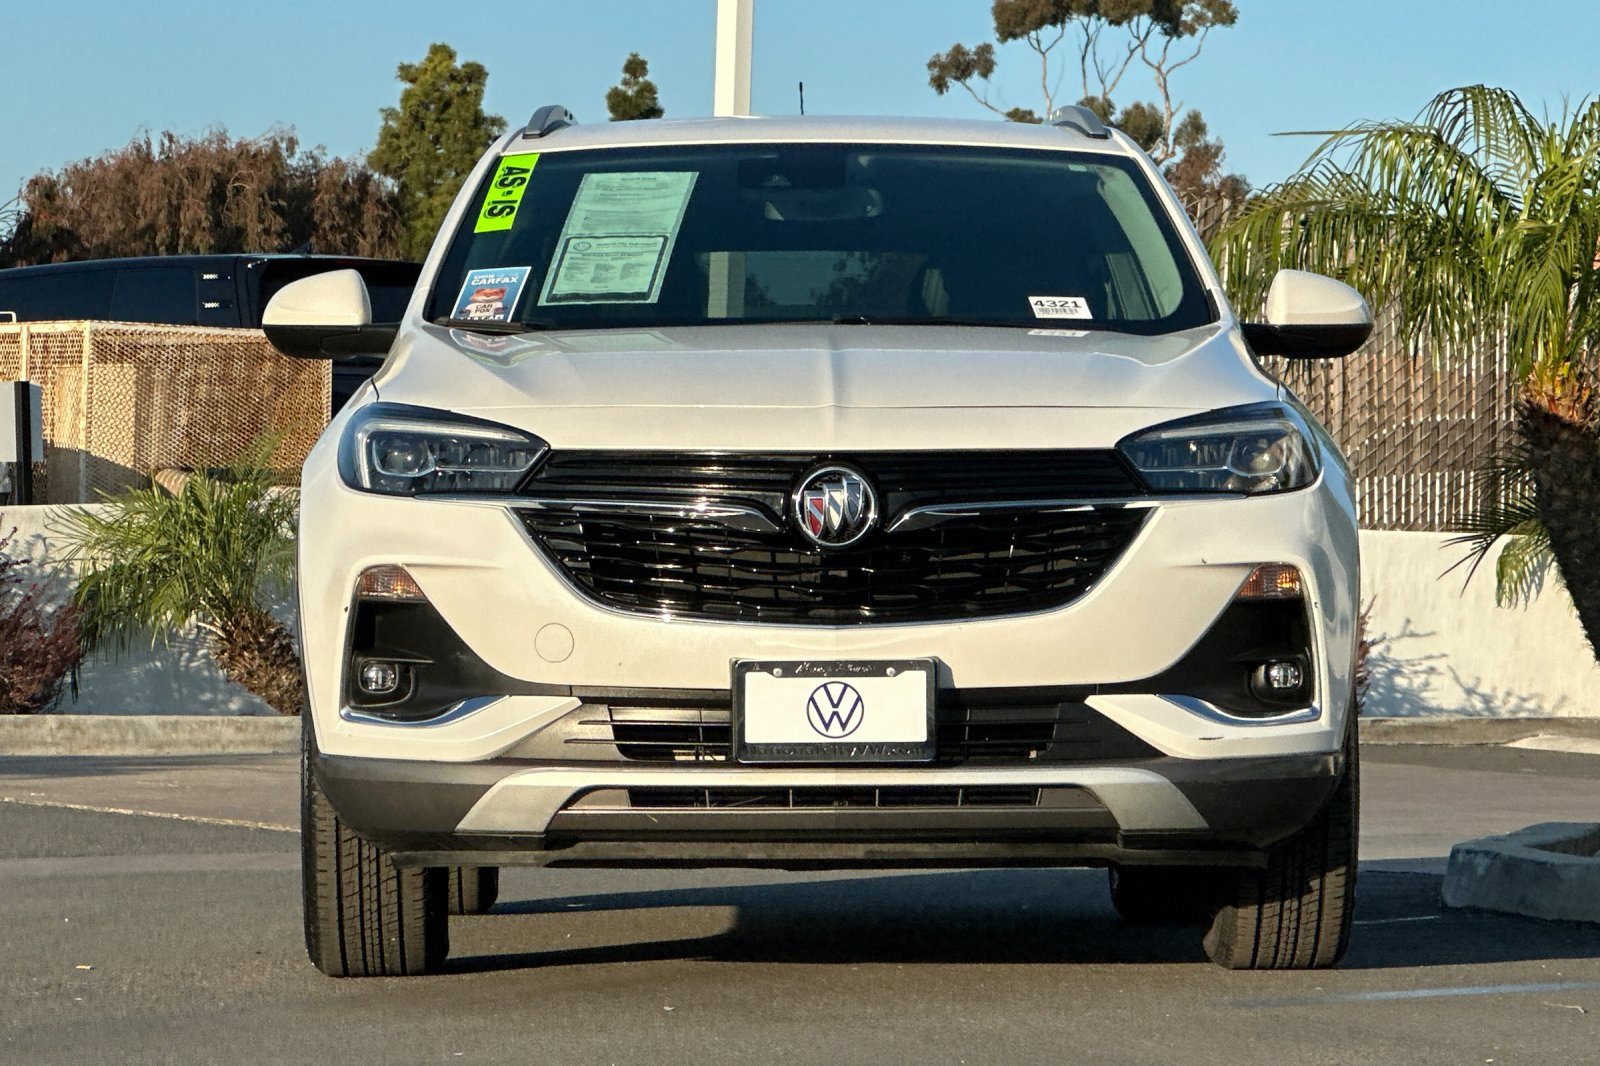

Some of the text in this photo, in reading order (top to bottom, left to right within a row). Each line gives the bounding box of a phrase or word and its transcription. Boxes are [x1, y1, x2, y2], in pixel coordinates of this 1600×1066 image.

[484, 166, 531, 219] AS-IS
[471, 276, 518, 286] CARFAX
[807, 681, 864, 739] VW
